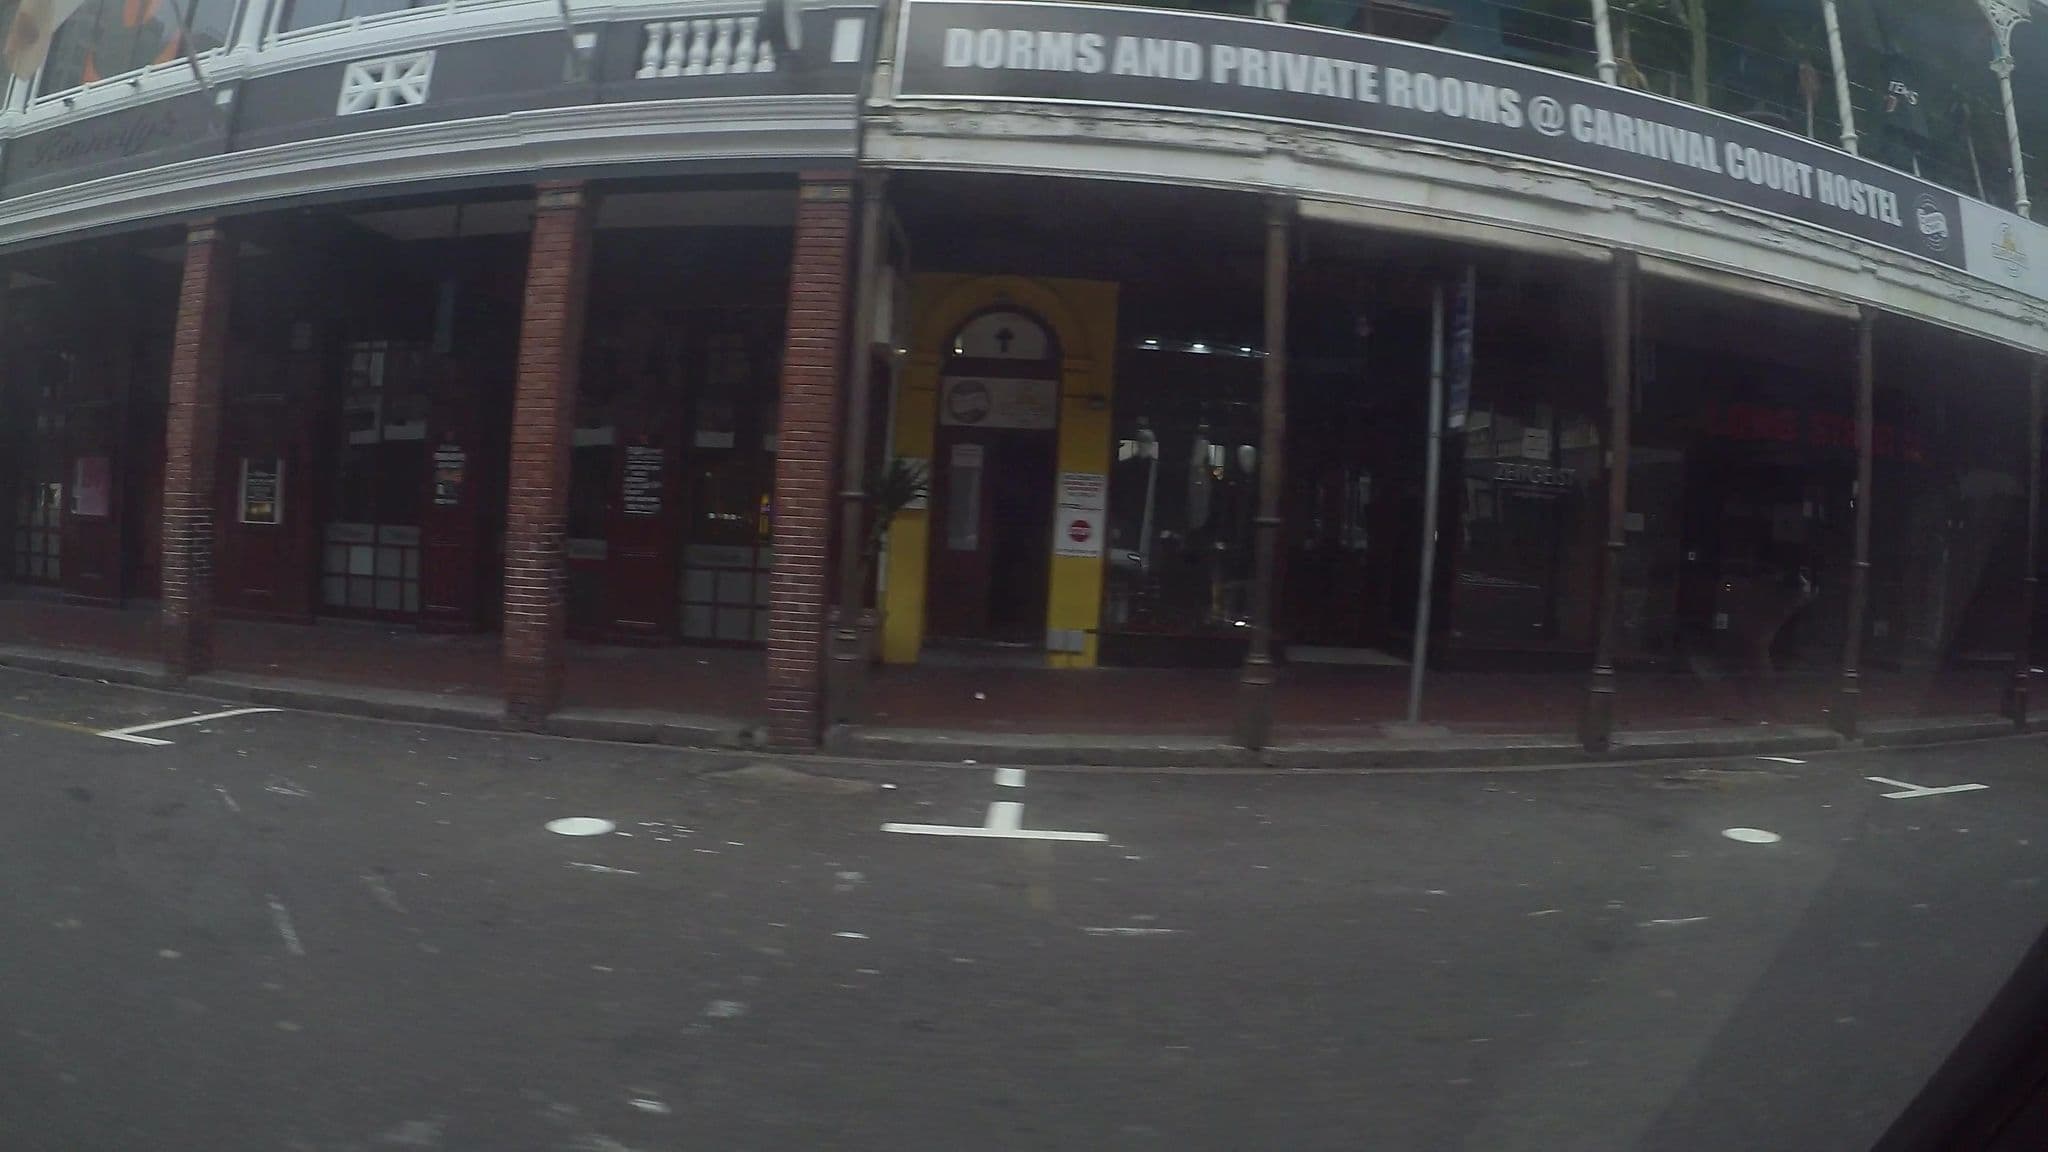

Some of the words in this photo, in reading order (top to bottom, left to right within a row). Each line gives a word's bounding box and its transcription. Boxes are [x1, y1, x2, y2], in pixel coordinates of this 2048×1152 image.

[943, 28, 1105, 74] DORMS
[1111, 37, 1203, 81] AND
[1210, 44, 1379, 104] PRIVATE
[1385, 68, 1523, 128] ROOMS
[1529, 96, 1566, 137] @
[1570, 104, 1721, 174] CARNIVAL
[1725, 142, 1813, 198] COURT
[1818, 170, 1902, 227] HOSTEL
